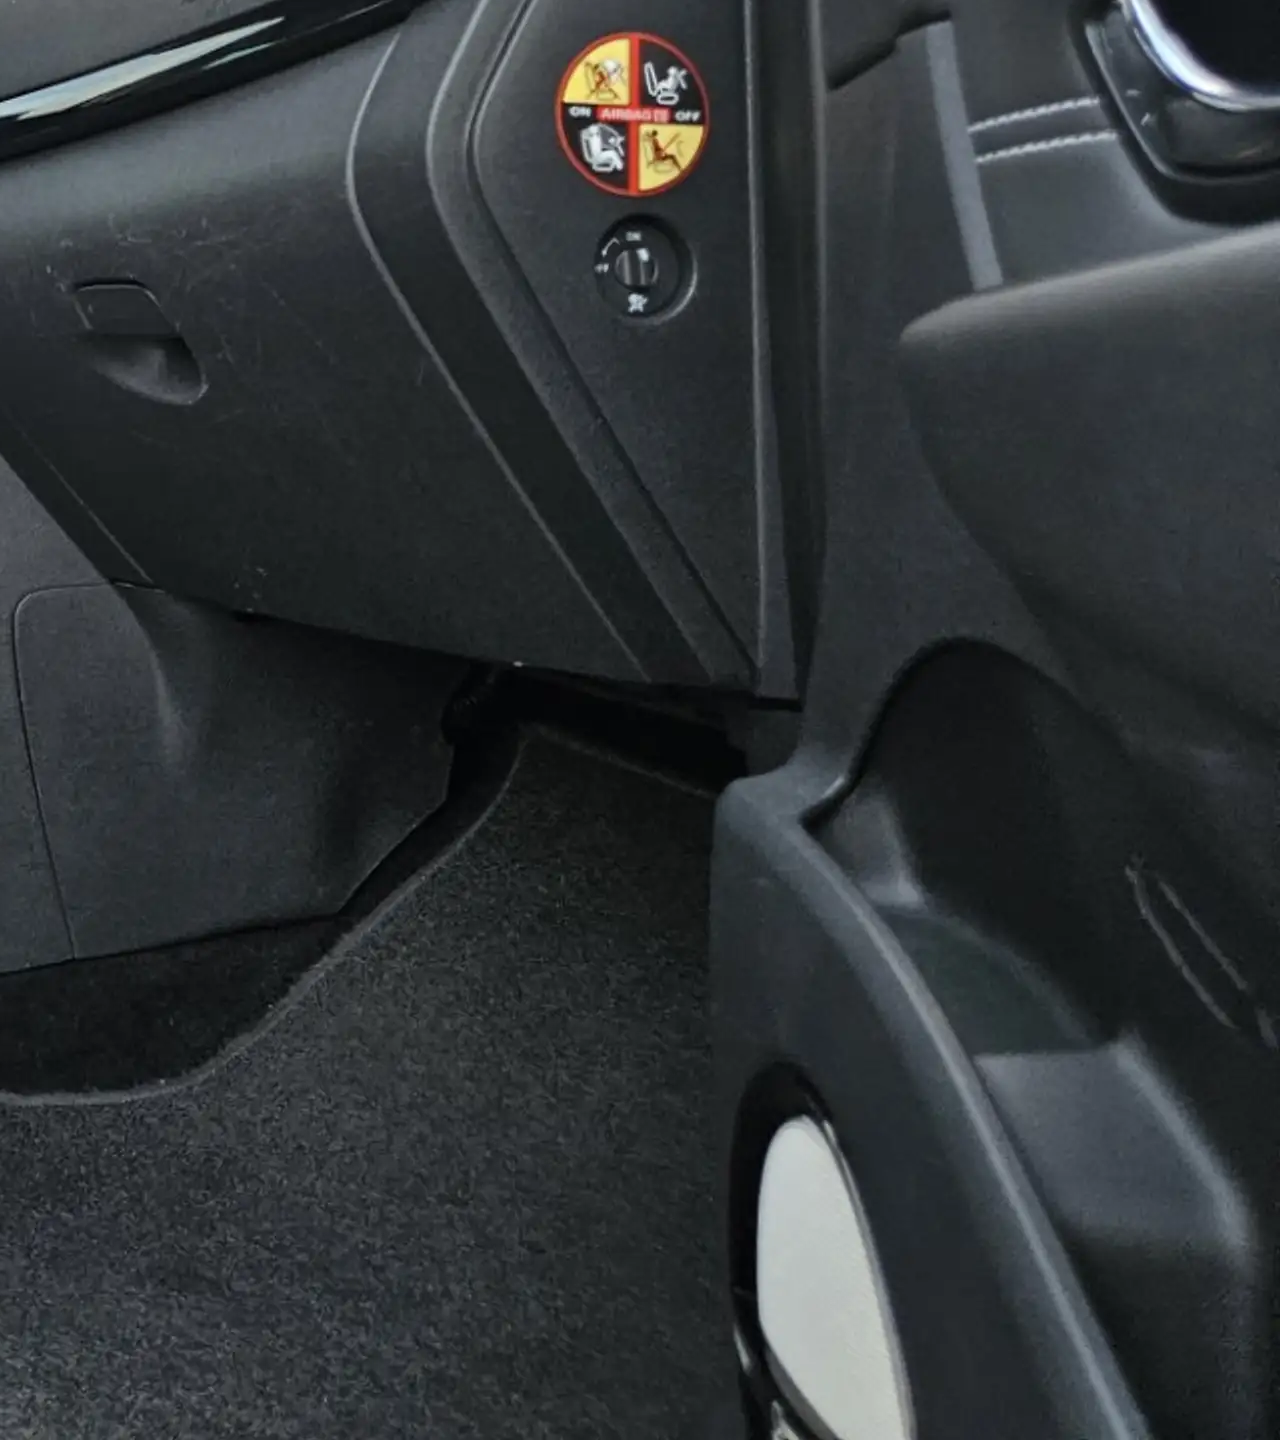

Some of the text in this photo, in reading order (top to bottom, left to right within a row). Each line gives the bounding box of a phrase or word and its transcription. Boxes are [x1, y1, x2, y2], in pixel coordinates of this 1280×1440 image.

[568, 106, 701, 122] ON AIRBAG OFF
